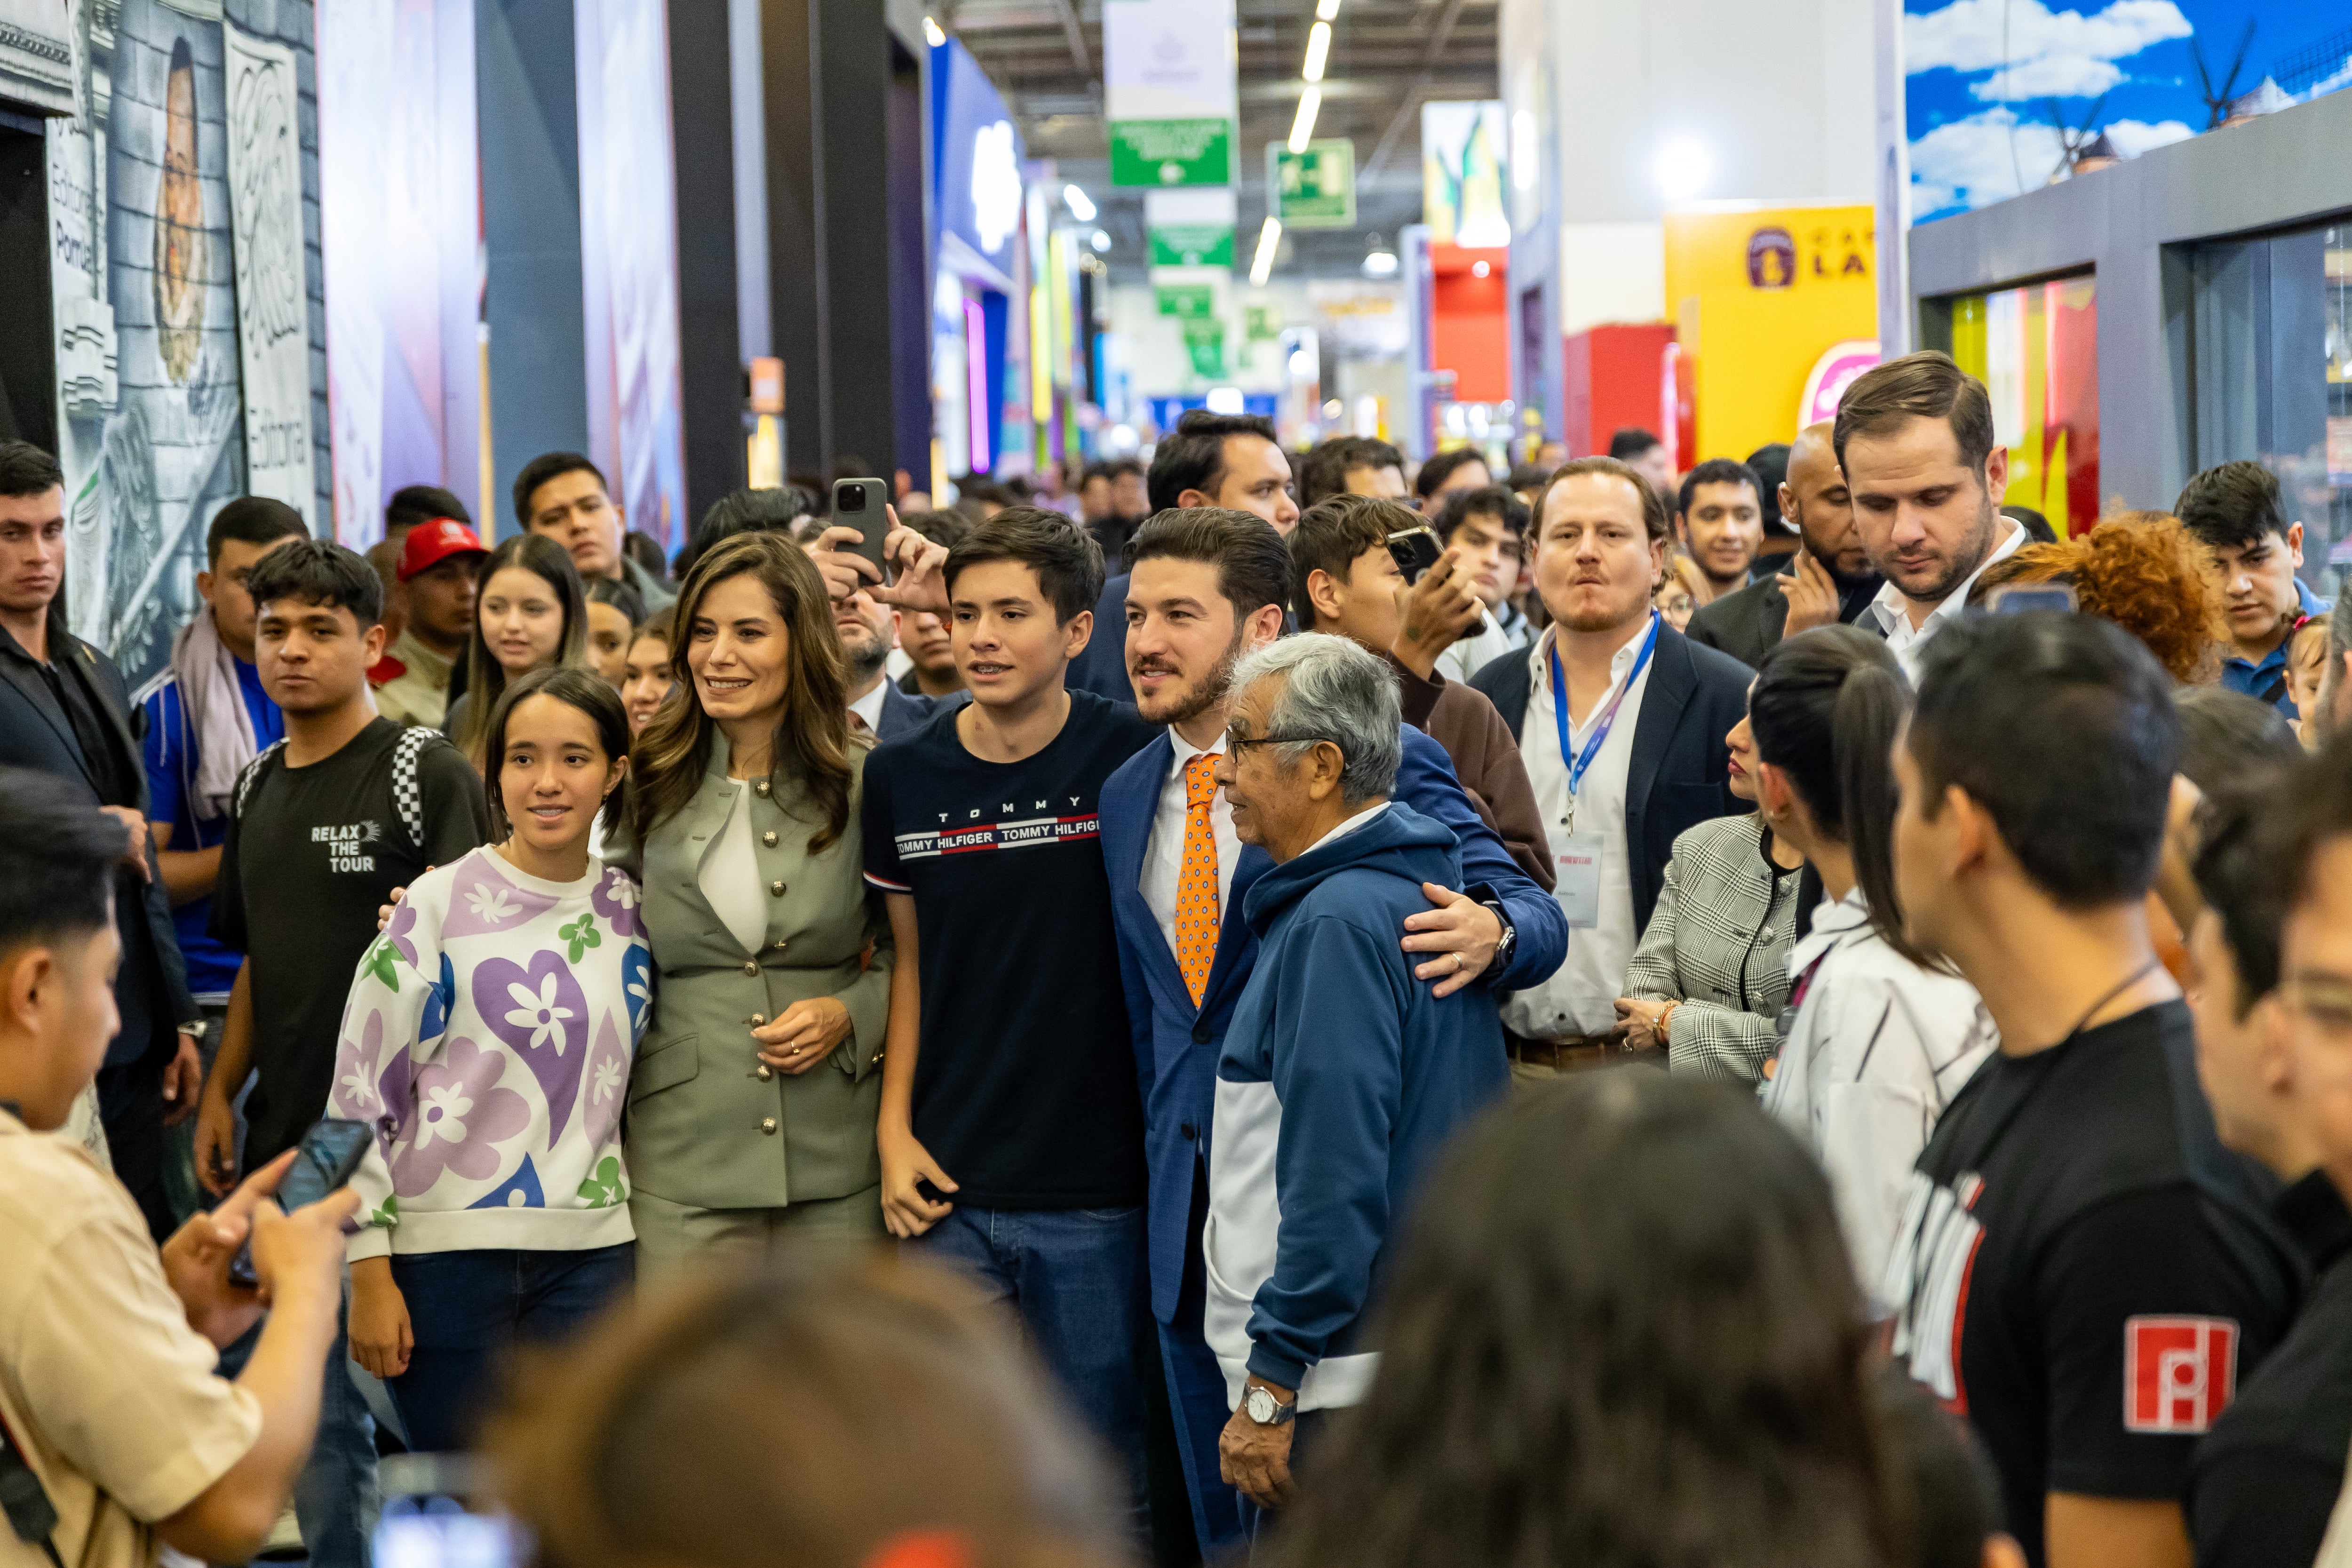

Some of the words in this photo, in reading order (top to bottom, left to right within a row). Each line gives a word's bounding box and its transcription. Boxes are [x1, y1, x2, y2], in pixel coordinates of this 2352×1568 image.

[1812, 252, 1867, 279] LA
[938, 797, 1081, 822] TOMMY
[311, 824, 359, 842] RELAX
[897, 839, 933, 854] TOMMY
[938, 832, 993, 849] HILFIGER
[1001, 825, 1049, 841] TOMMY
[329, 840, 359, 856] THE
[330, 856, 374, 873] TOUR
